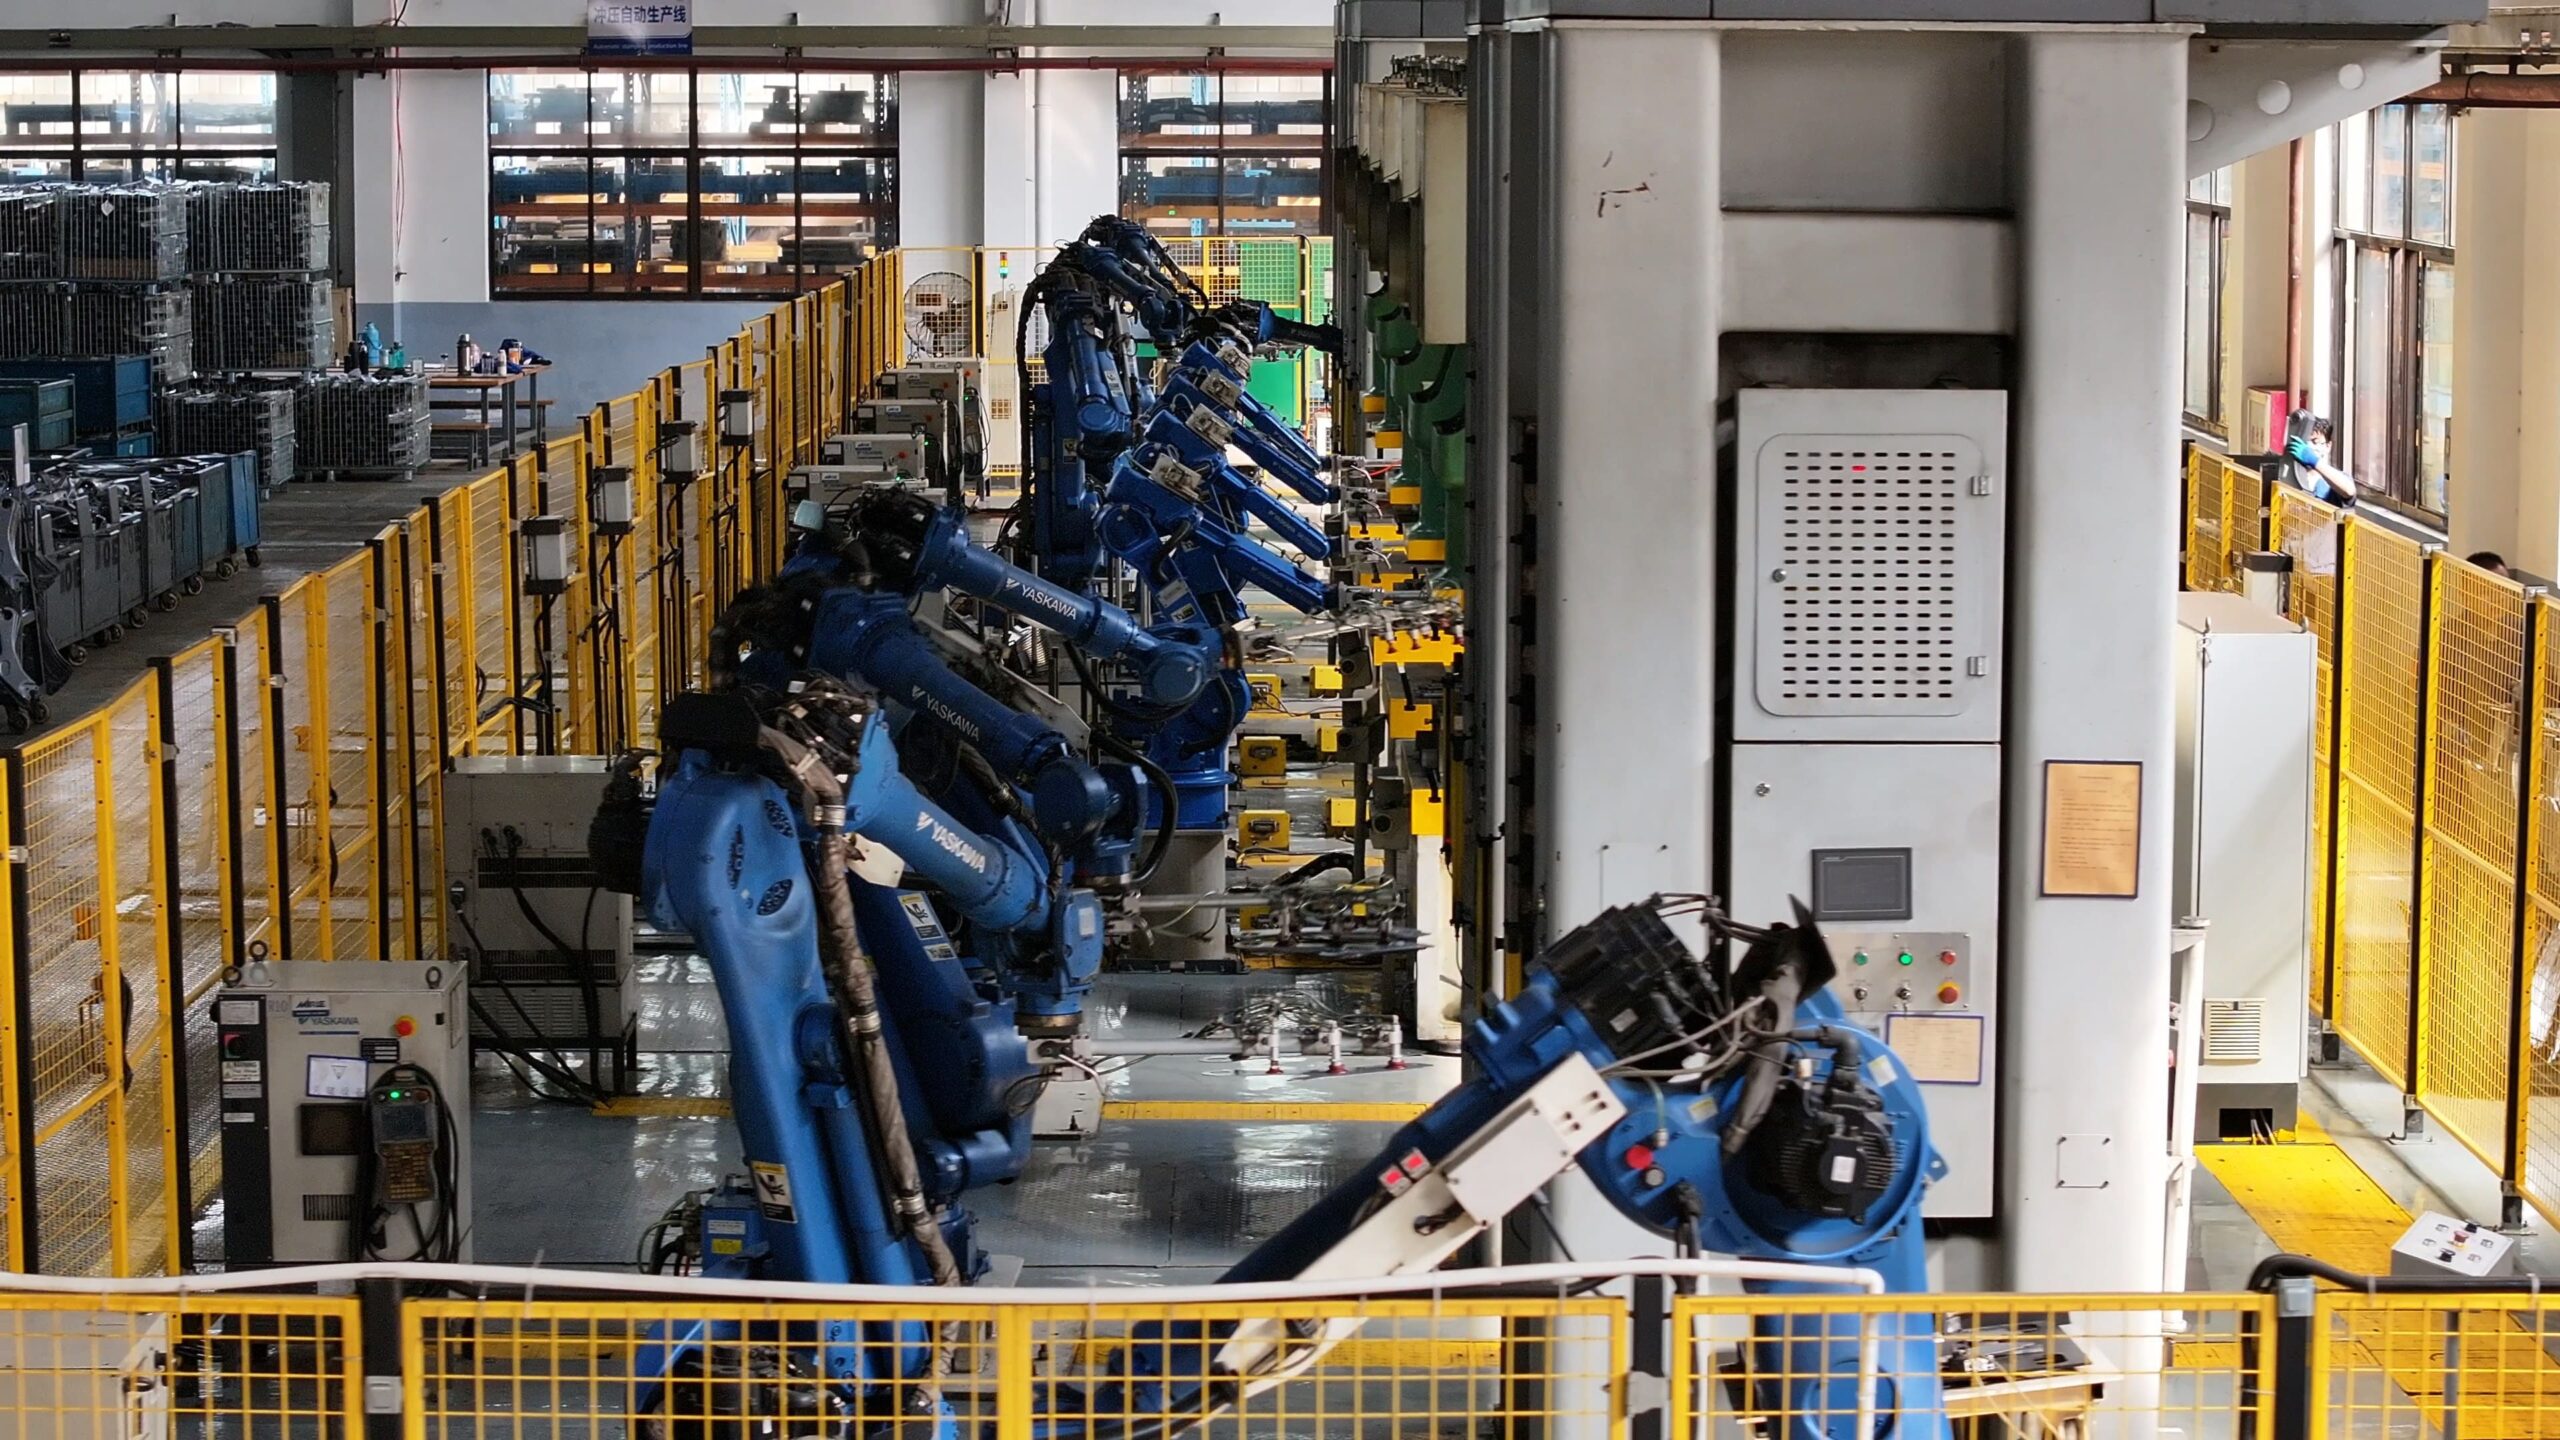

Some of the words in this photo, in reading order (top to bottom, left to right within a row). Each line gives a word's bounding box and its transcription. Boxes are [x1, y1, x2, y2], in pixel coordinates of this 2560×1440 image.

[594, 5, 687, 24] 冲压自动生产线
[1022, 584, 1077, 620] YASKAWA
[927, 694, 980, 742] YASKAWA
[931, 821, 986, 874] YASKAWA
[311, 1016, 360, 1026] YASKAWA
